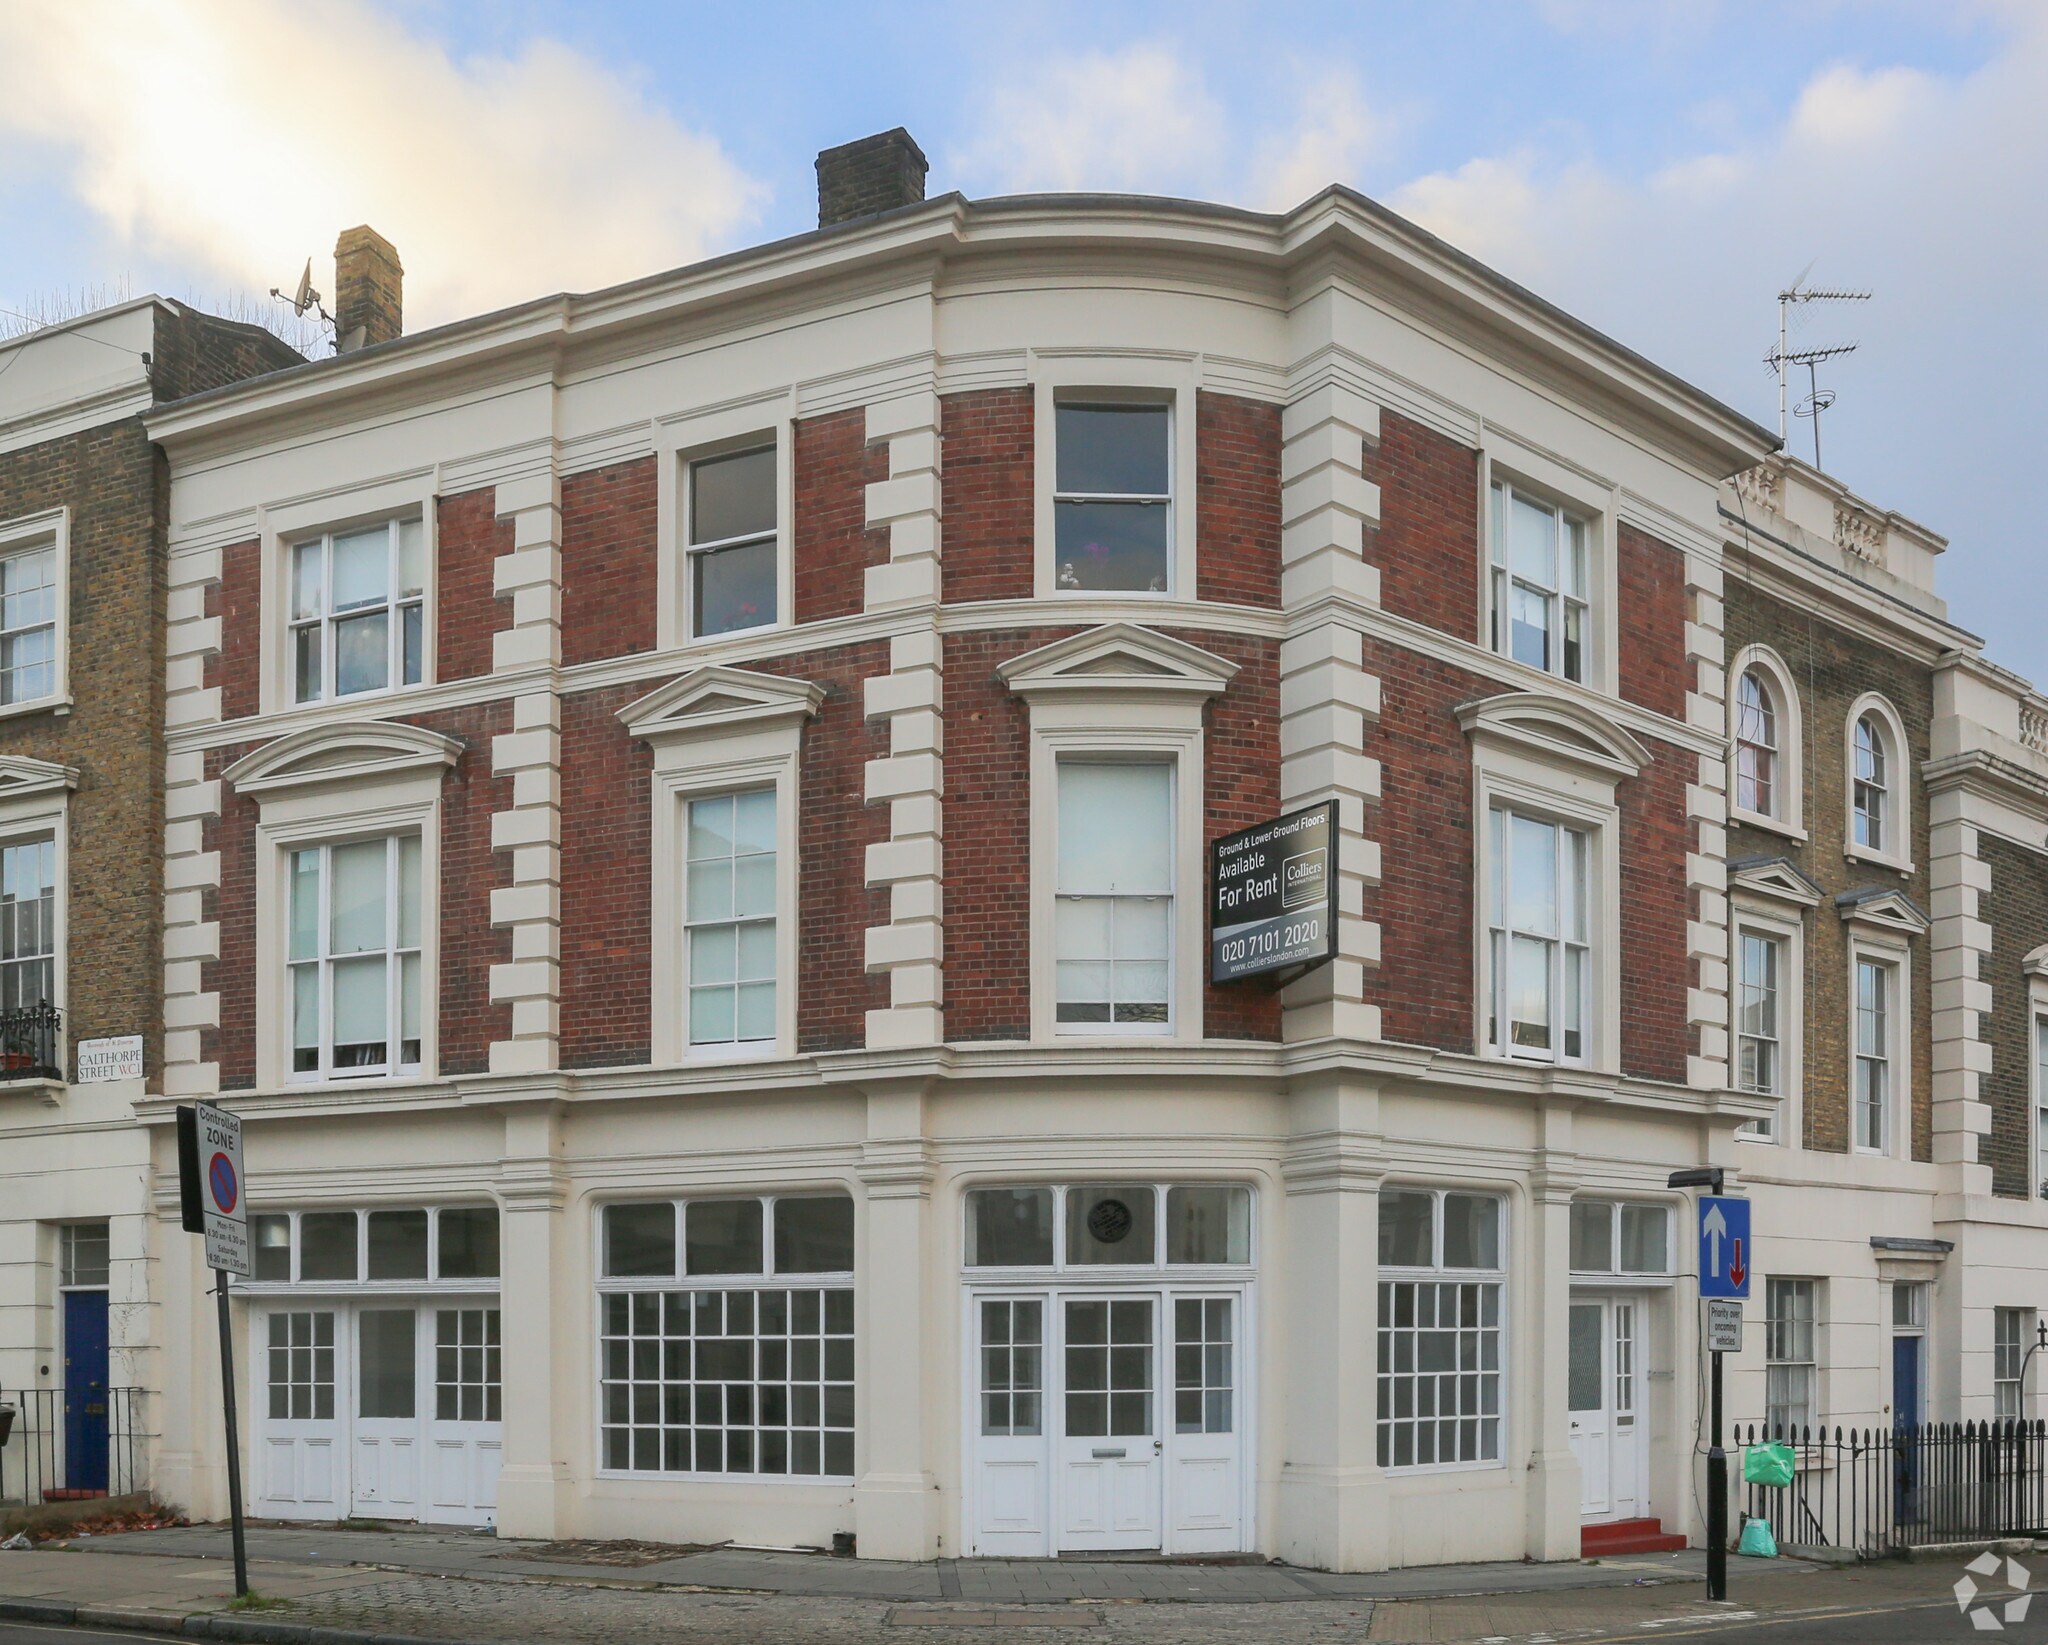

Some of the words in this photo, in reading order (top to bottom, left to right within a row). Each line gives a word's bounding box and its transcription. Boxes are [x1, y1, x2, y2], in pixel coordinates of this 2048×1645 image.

[1219, 842, 1243, 857] Ground
[1244, 838, 1250, 848] &
[1251, 831, 1272, 847] Lower
[1273, 822, 1300, 839] Ground
[1301, 813, 1325, 830] Floors
[1219, 852, 1265, 881] Available
[1287, 861, 1322, 881] Colliers
[1219, 887, 1242, 910] For
[1246, 873, 1278, 902] Rent
[1222, 939, 1245, 963] 020
[1249, 929, 1279, 956] 7101
[1284, 919, 1318, 947] 2020
[1230, 946, 1309, 973] www.collierslondon.com
[79, 1050, 141, 1066] CALTHORPE
[80, 1065, 115, 1079] STREET
[200, 1107, 239, 1132] Controlled
[207, 1127, 234, 1151] ZONE
[1711, 1307, 1729, 1320] Priority
[1716, 1335, 1735, 1346] vehicles
